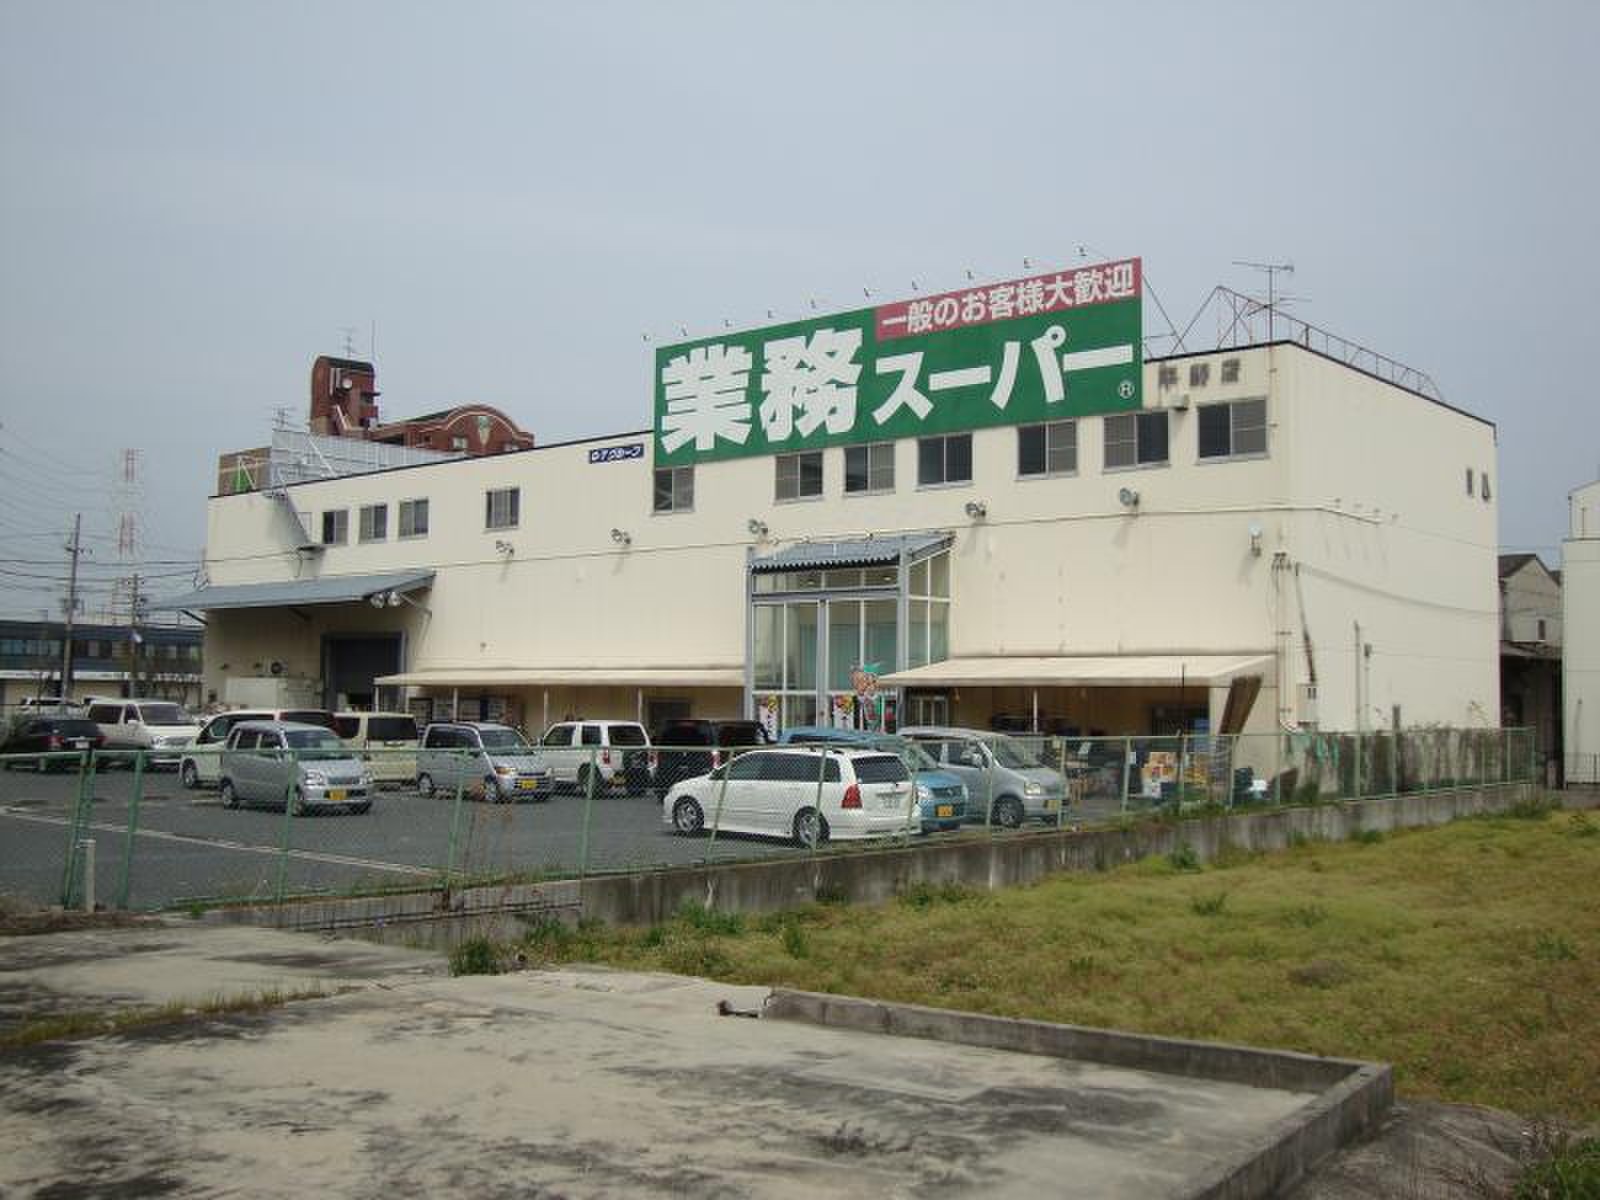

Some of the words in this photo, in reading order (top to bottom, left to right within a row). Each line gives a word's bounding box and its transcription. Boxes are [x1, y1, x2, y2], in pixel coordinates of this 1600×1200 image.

[882, 262, 1135, 332] 一般のお客様大歓迎
[660, 325, 1133, 454] 業務スーパー
